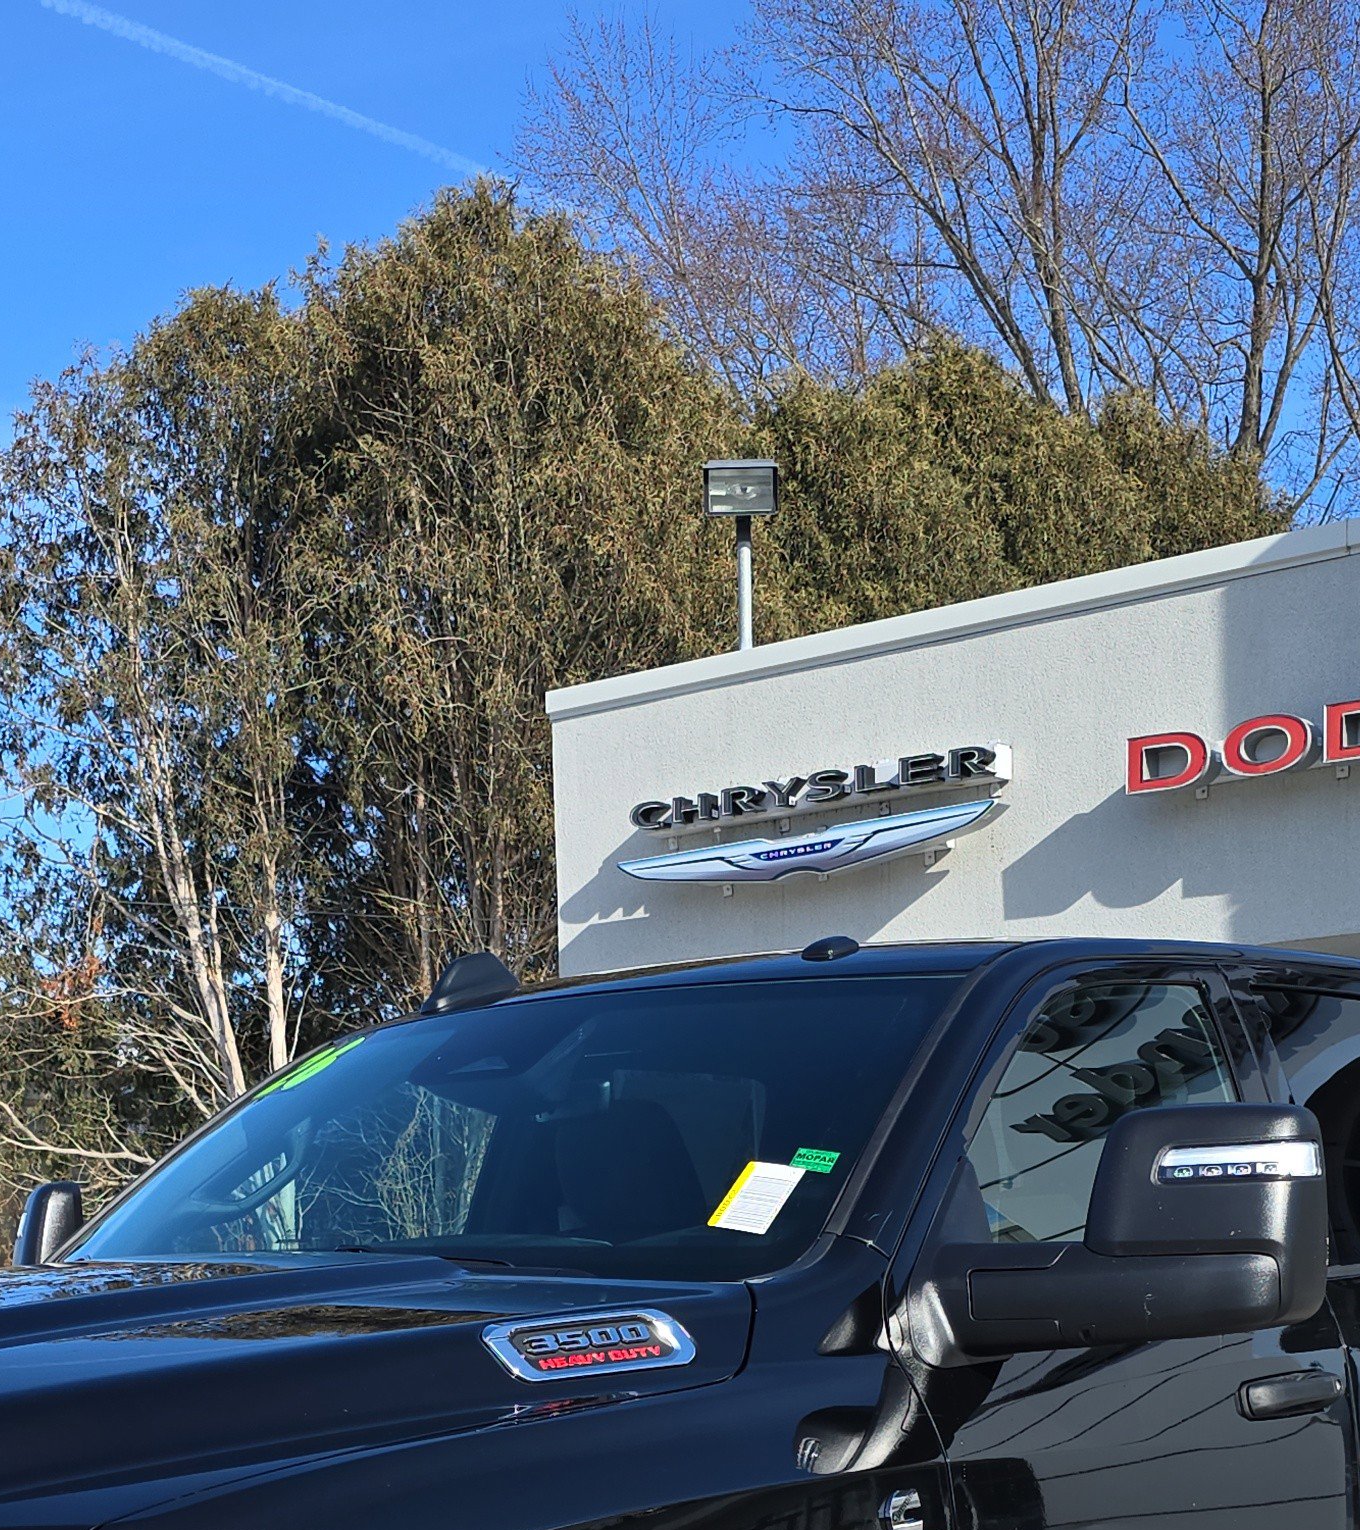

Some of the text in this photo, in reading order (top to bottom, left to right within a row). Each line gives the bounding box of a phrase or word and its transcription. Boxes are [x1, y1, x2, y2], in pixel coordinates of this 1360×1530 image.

[629, 746, 996, 830] CHRYSLER
[759, 842, 833, 860] CHRYSLER
[795, 1153, 836, 1164] MOPAR
[522, 1321, 651, 1356] 3500
[538, 1345, 661, 1371] HEAVY DUTY
